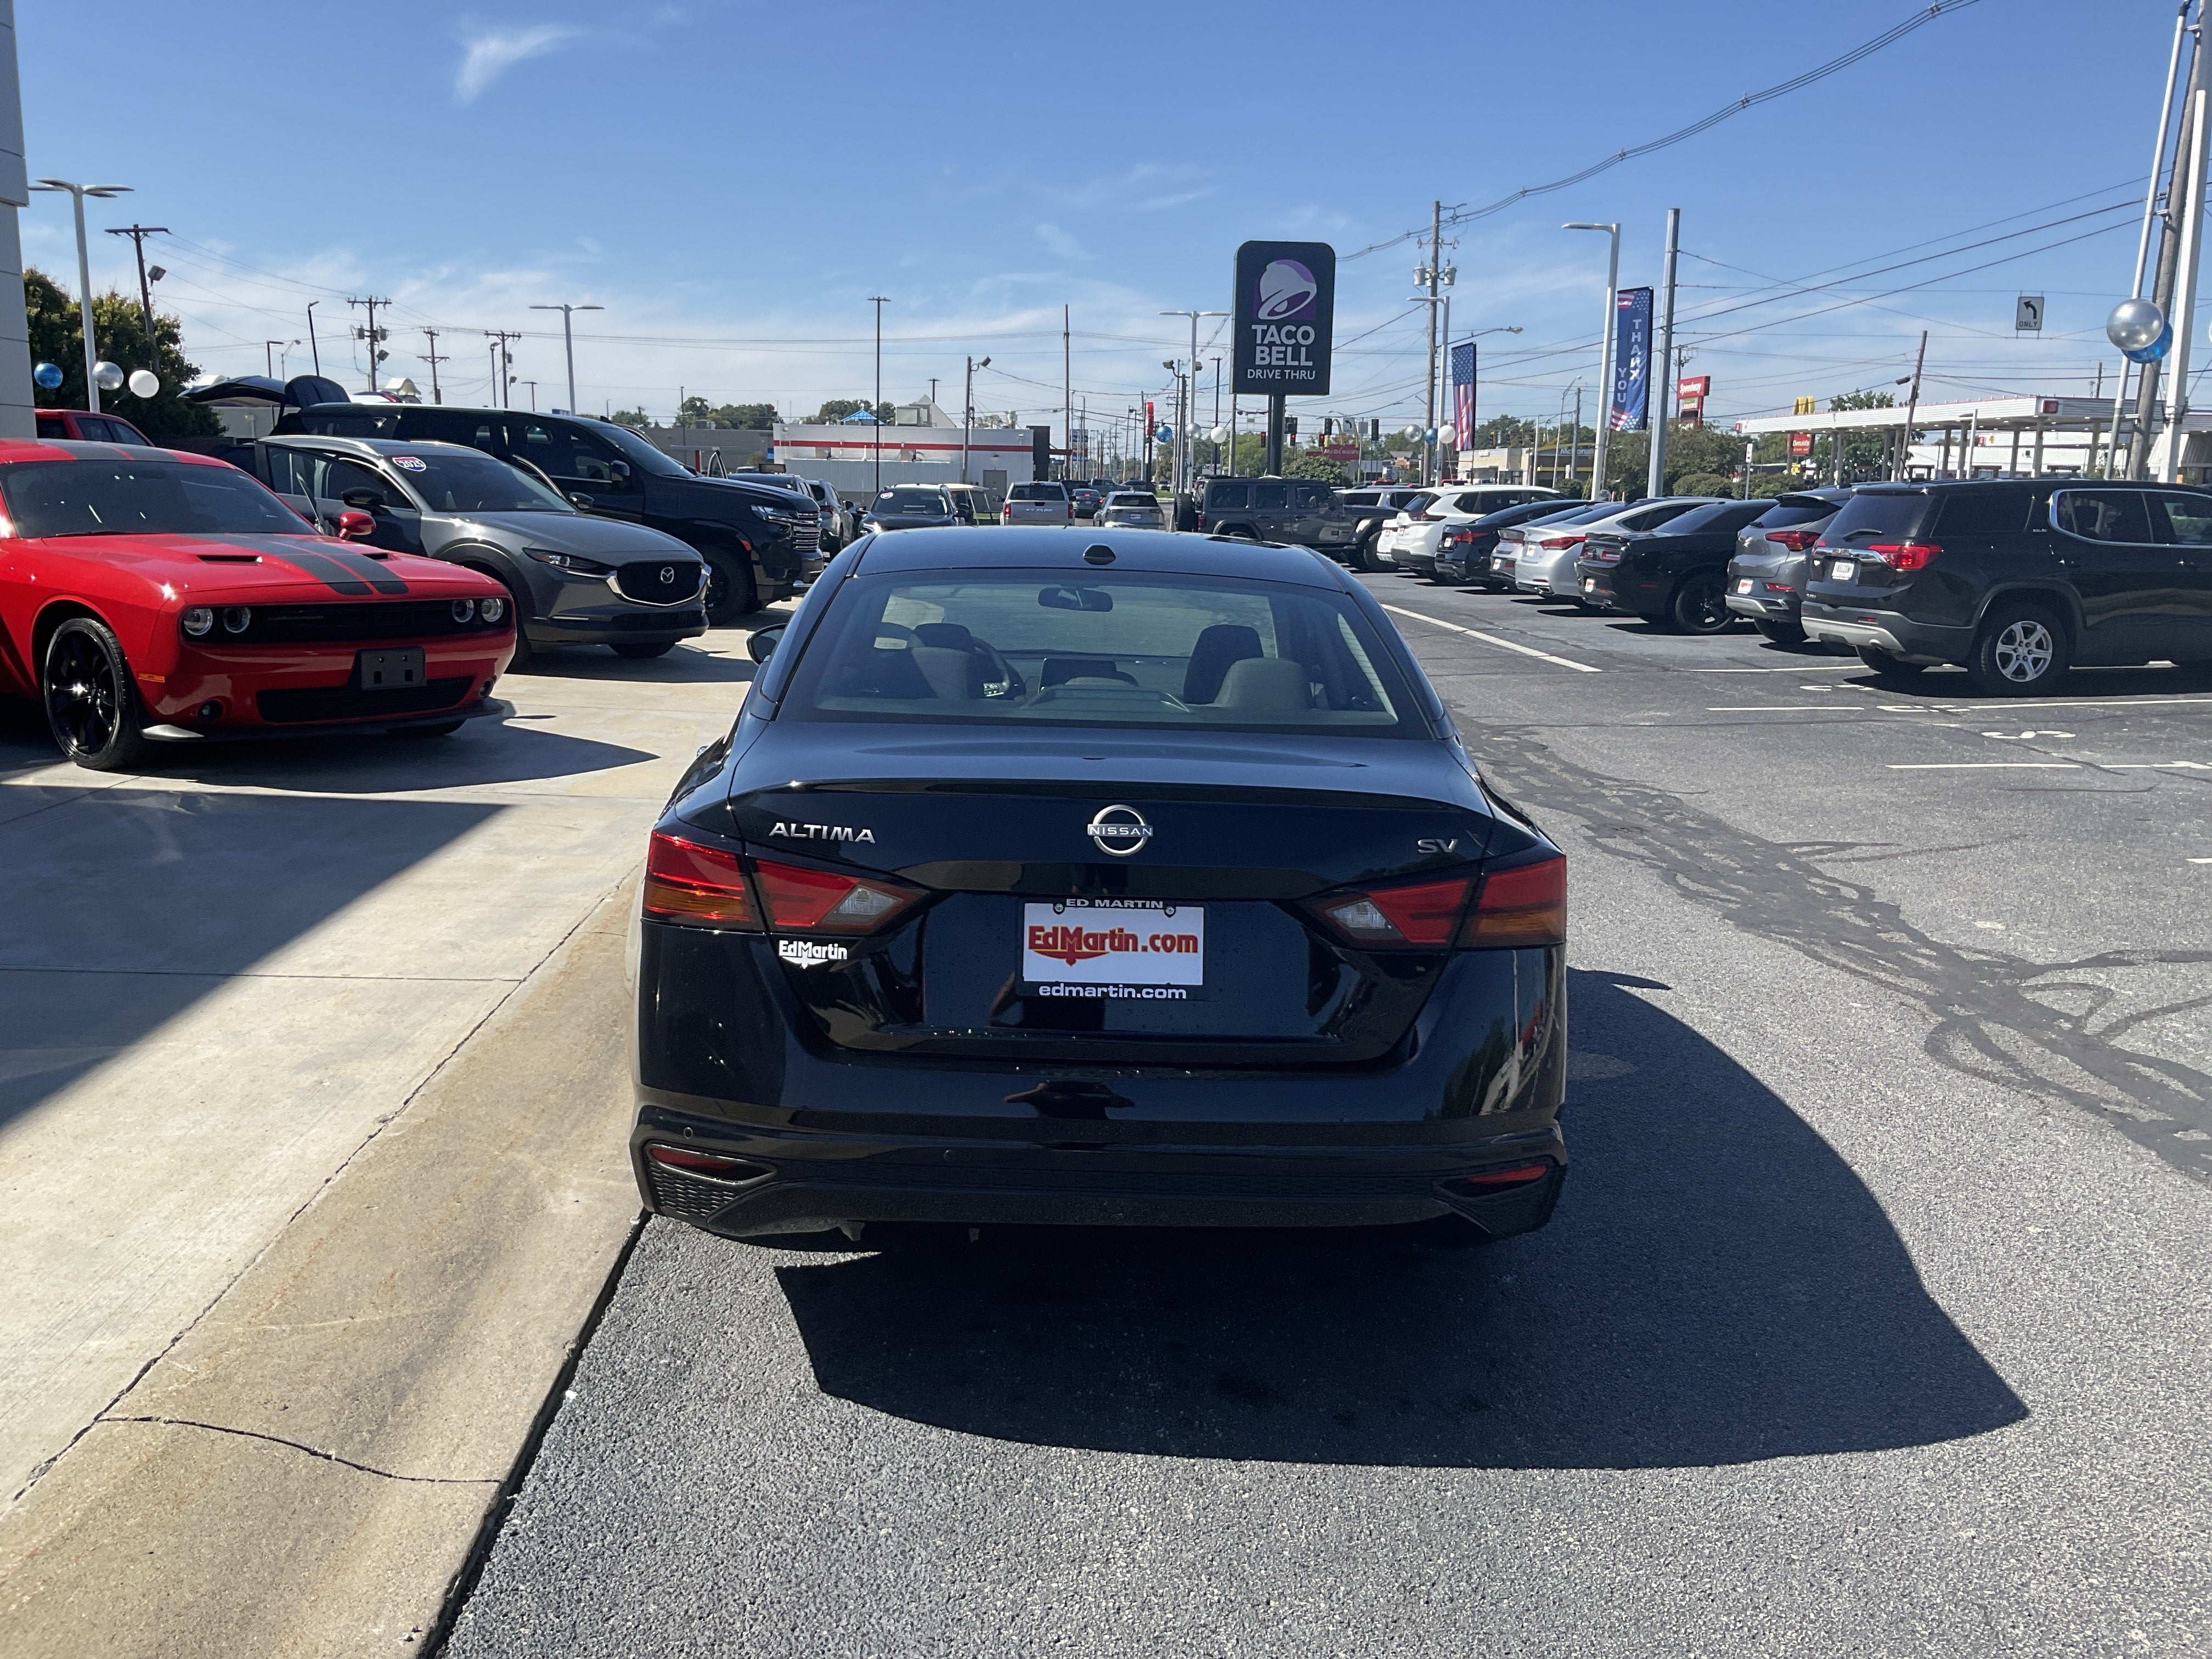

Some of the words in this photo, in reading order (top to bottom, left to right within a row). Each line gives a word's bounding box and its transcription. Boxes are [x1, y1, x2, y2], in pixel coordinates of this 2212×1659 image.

[1251, 325, 1315, 345] TACO
[1255, 346, 1313, 366] BELL
[1629, 319, 1642, 380] THANK
[1247, 369, 1282, 380] DRIVE
[1284, 369, 1316, 380] THRU
[1617, 368, 1628, 403] YOU
[769, 822, 876, 844] ALTIMA
[1089, 826, 1152, 836] NISSAN
[1417, 838, 1458, 854] SV
[1066, 898, 1090, 907] ED
[1094, 899, 1164, 909] MARTIN
[1028, 924, 1199, 954] EdMartin.com
[778, 939, 848, 960] EdMartin
[1038, 983, 1187, 1000] edmartin.com
